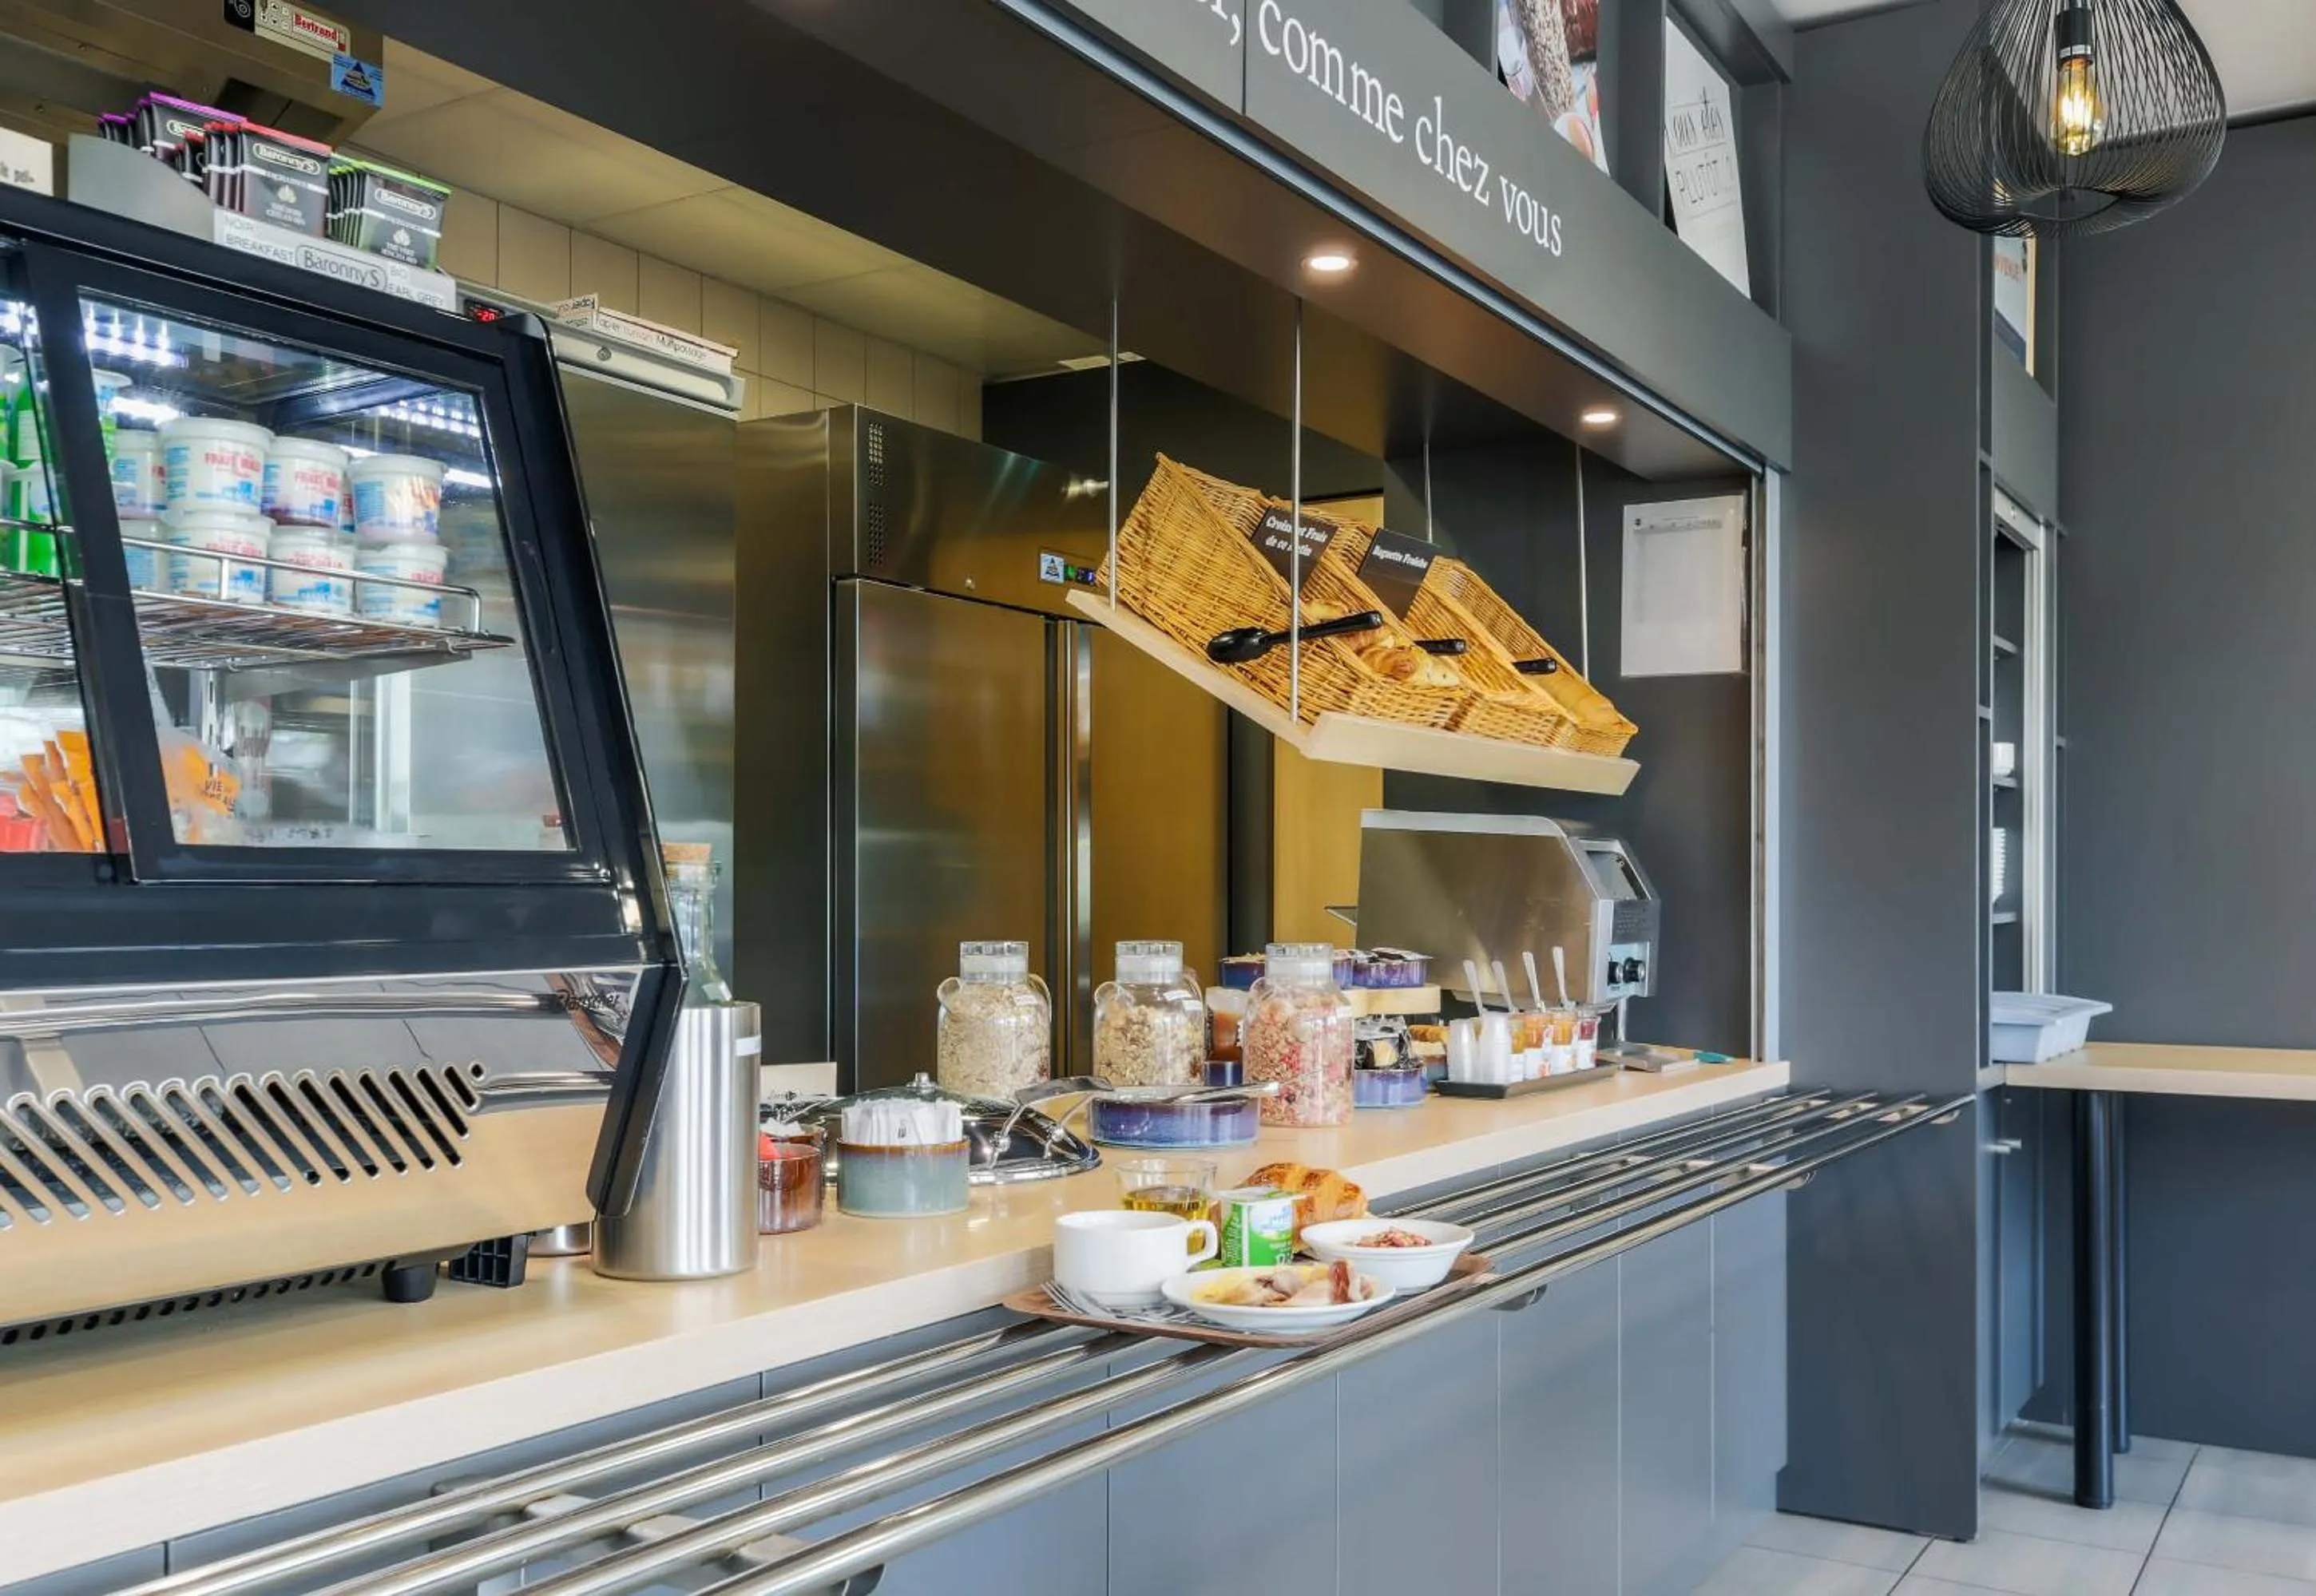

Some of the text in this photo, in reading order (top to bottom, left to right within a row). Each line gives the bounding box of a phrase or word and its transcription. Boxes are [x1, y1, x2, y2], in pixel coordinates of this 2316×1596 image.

[294, 13, 337, 40] Bertrand
[1259, 0, 1404, 144] comme
[1415, 96, 1489, 208] chez
[1499, 174, 1562, 256] vous
